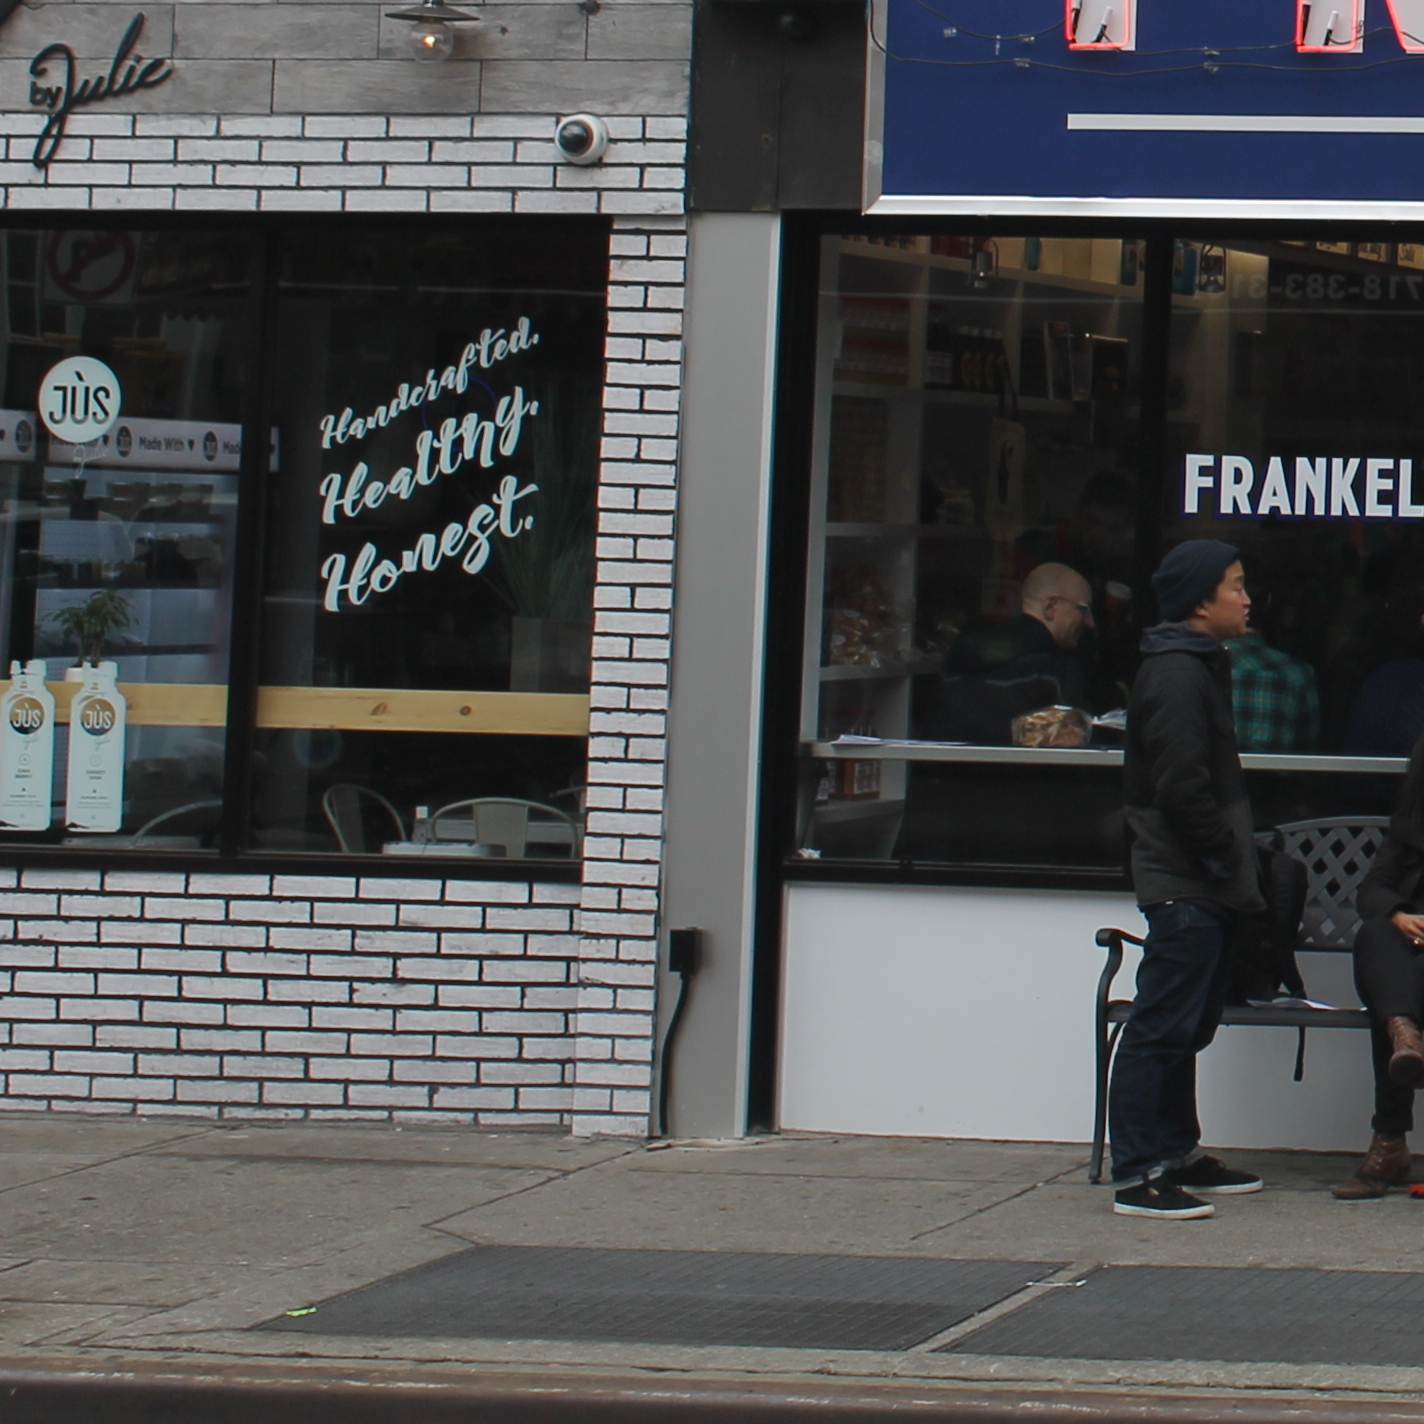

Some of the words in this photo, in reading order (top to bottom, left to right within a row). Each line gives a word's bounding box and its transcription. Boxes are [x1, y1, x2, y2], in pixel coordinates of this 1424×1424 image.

[29, 81, 60, 108] by
[30, 11, 174, 170] Julie
[48, 370, 112, 425] JÙS
[222, 440, 242, 456] Mad
[319, 317, 541, 450] Handcrafted.
[318, 386, 540, 525] Healthy.
[320, 475, 540, 613] Honest.
